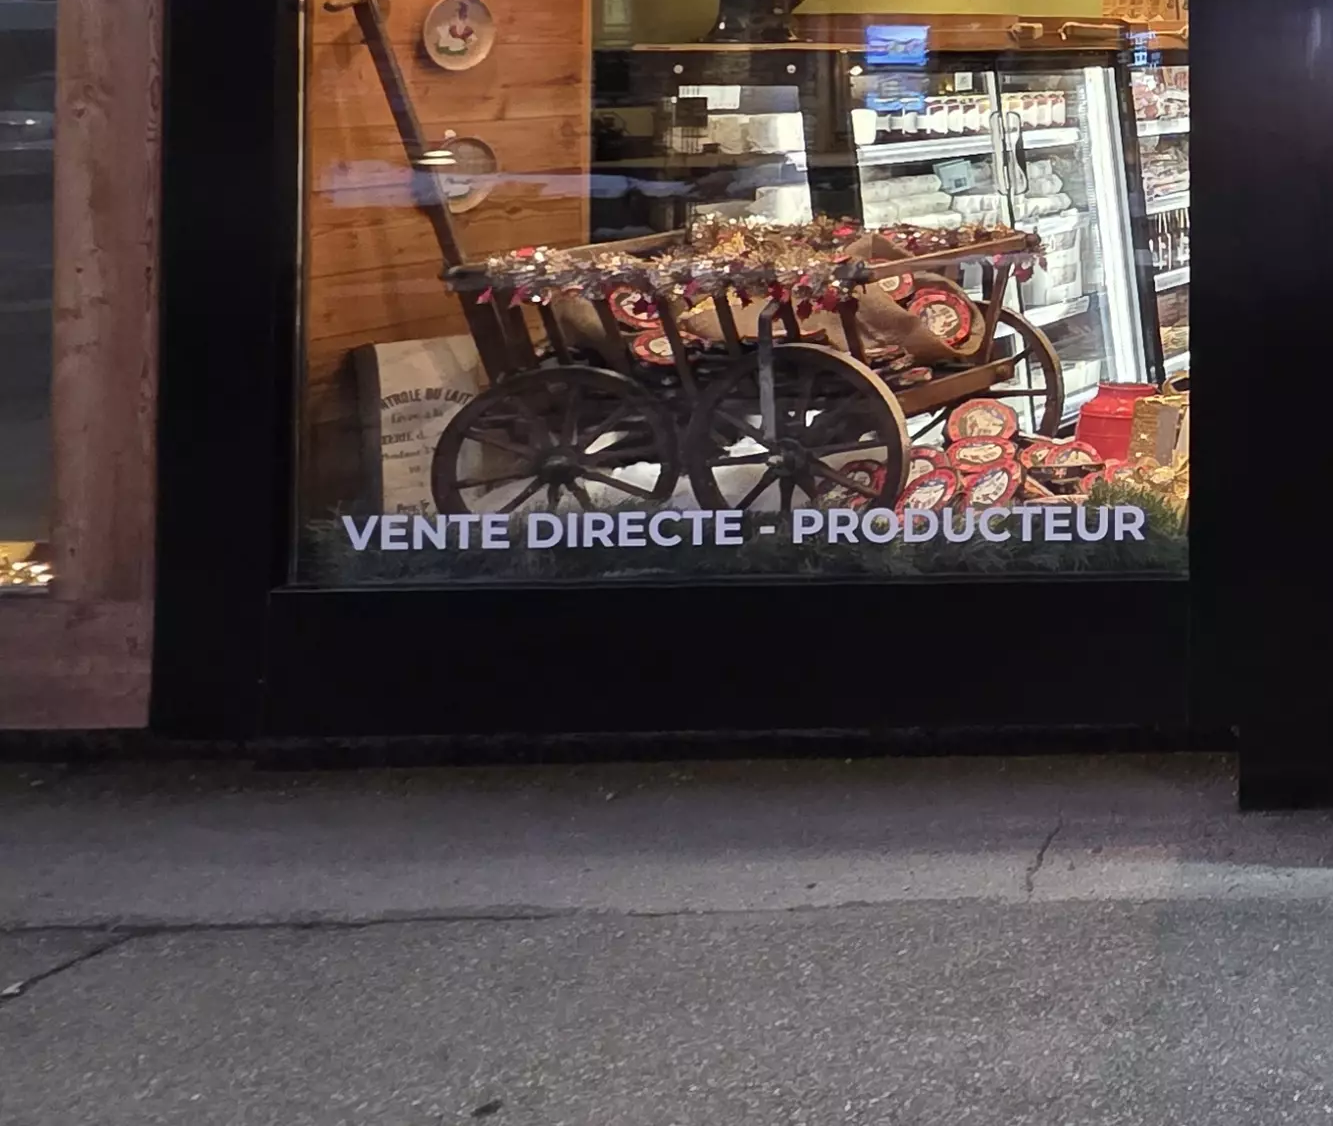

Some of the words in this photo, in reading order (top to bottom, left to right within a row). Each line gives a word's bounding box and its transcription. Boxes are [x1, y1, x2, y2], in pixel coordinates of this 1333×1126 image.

[342, 514, 511, 551] VENTE
[527, 509, 744, 549] DIRECTE
[759, 525, 776, 534] -
[792, 504, 1146, 545] PRODUCTEUR
